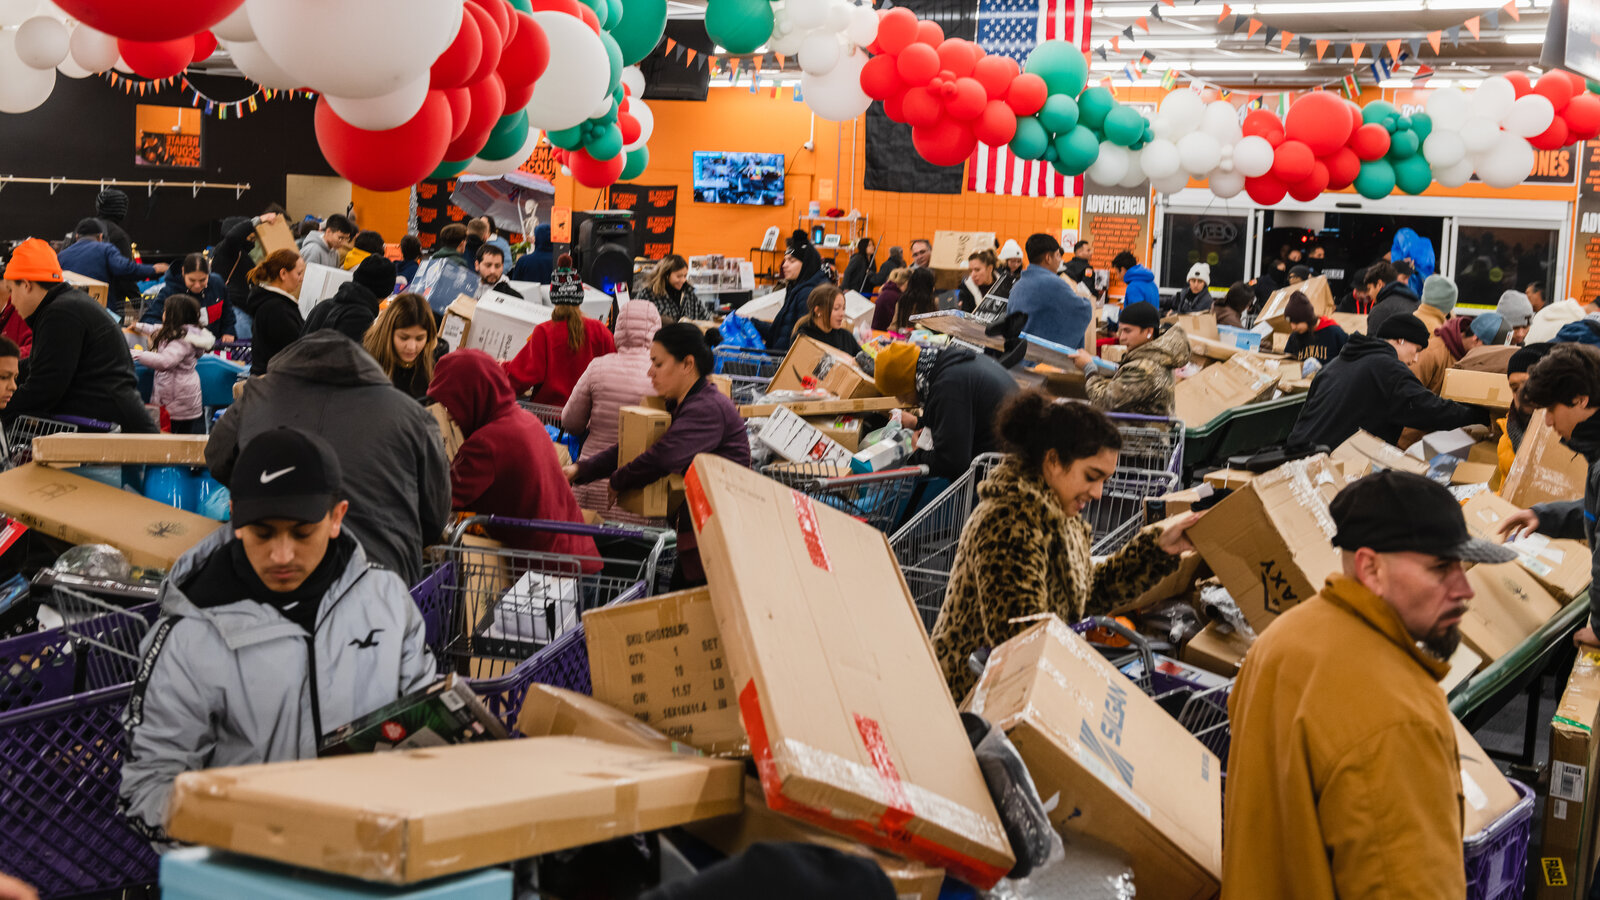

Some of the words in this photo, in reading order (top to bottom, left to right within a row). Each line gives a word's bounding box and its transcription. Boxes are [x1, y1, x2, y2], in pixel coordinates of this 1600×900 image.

[1086, 194, 1146, 216] ADVERTENCIA
[1298, 345, 1327, 361] HAWAII
[1260, 560, 1301, 604] AXY
[629, 653, 646, 666] QTY:
[673, 646, 679, 657] 1
[702, 638, 718, 651] SET
[710, 658, 723, 671] LB
[672, 684, 691, 698] 11.57
[713, 677, 725, 691] LB
